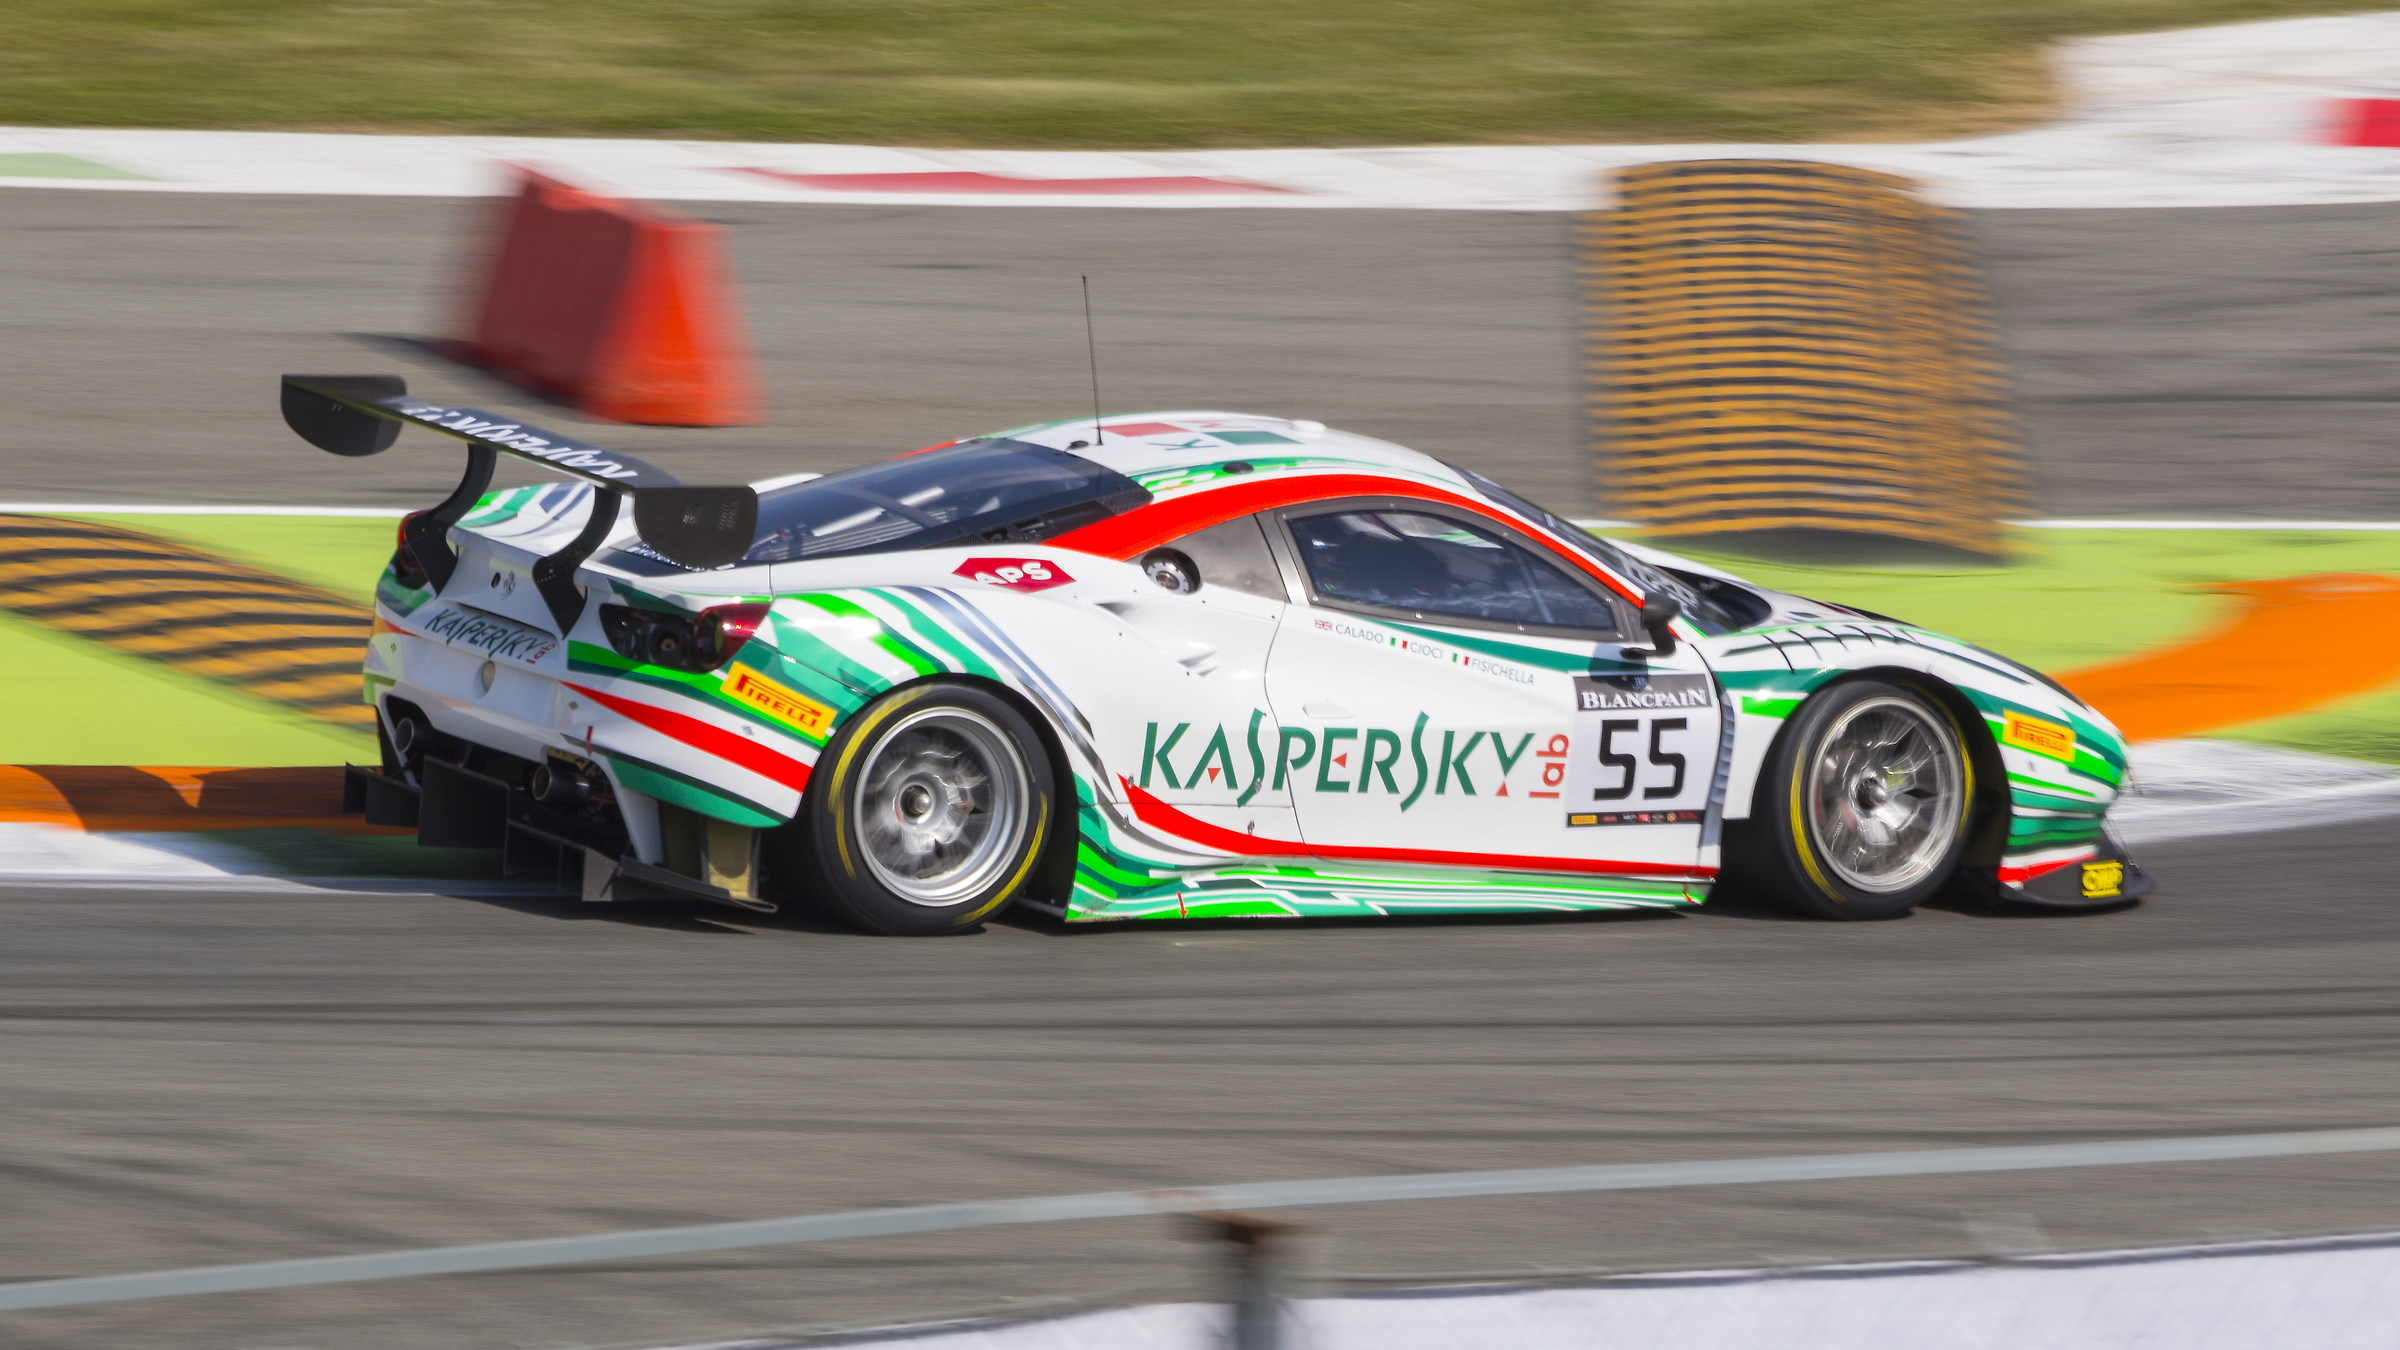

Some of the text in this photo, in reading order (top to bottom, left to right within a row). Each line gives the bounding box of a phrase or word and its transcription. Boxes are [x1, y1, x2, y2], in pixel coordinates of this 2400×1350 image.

[974, 562, 1052, 584] APS
[424, 608, 556, 665] KASPERSKY lab
[1335, 623, 1536, 686] CALADO CIOCI FISICHELLA
[735, 673, 822, 728] PIRELLI
[1580, 688, 1708, 710] BLANCPAIN
[1139, 707, 1570, 814] KASPERSKY lab
[1593, 717, 1688, 801] 55
